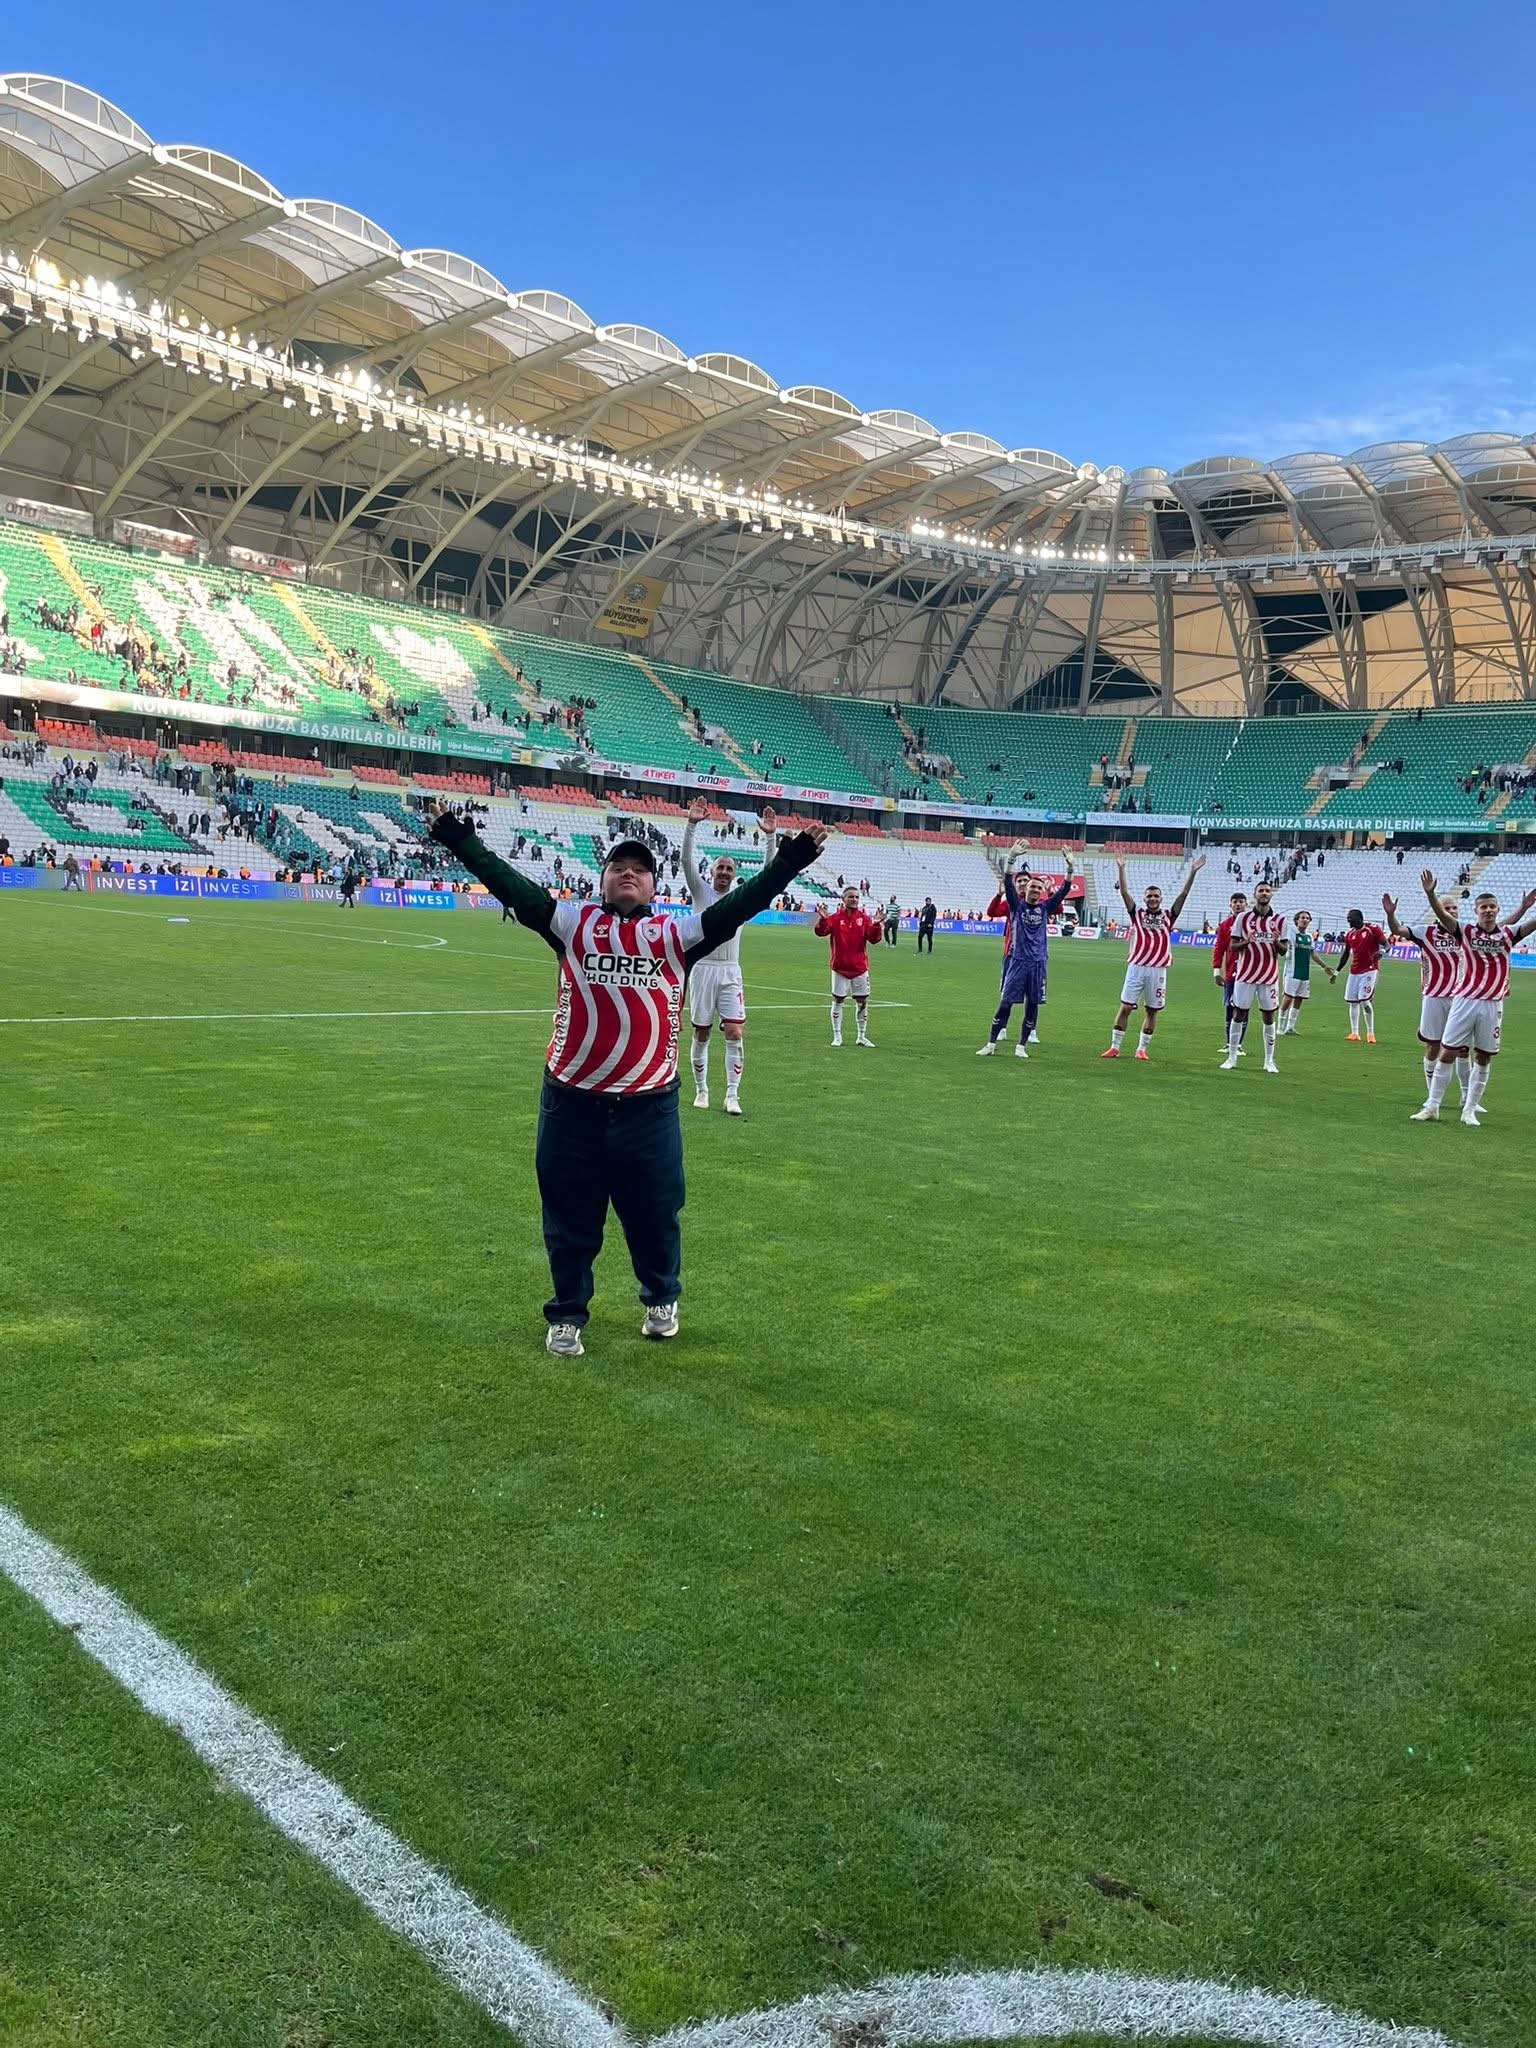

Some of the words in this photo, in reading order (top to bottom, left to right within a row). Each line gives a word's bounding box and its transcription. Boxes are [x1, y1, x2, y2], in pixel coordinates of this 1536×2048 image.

[300, 722, 383, 745] BAŞARILAR
[386, 731, 442, 751] DİLERİM
[1192, 817, 1302, 829] KONYASPOR'UMUZA
[1304, 818, 1371, 831] BAŞARILAR
[1375, 817, 1425, 831] DİLERİM
[204, 881, 260, 894] INVEST
[311, 888, 361, 901] INVET
[404, 893, 450, 905] INVEST
[584, 953, 665, 977] COREX
[586, 972, 659, 988] HOLDING
